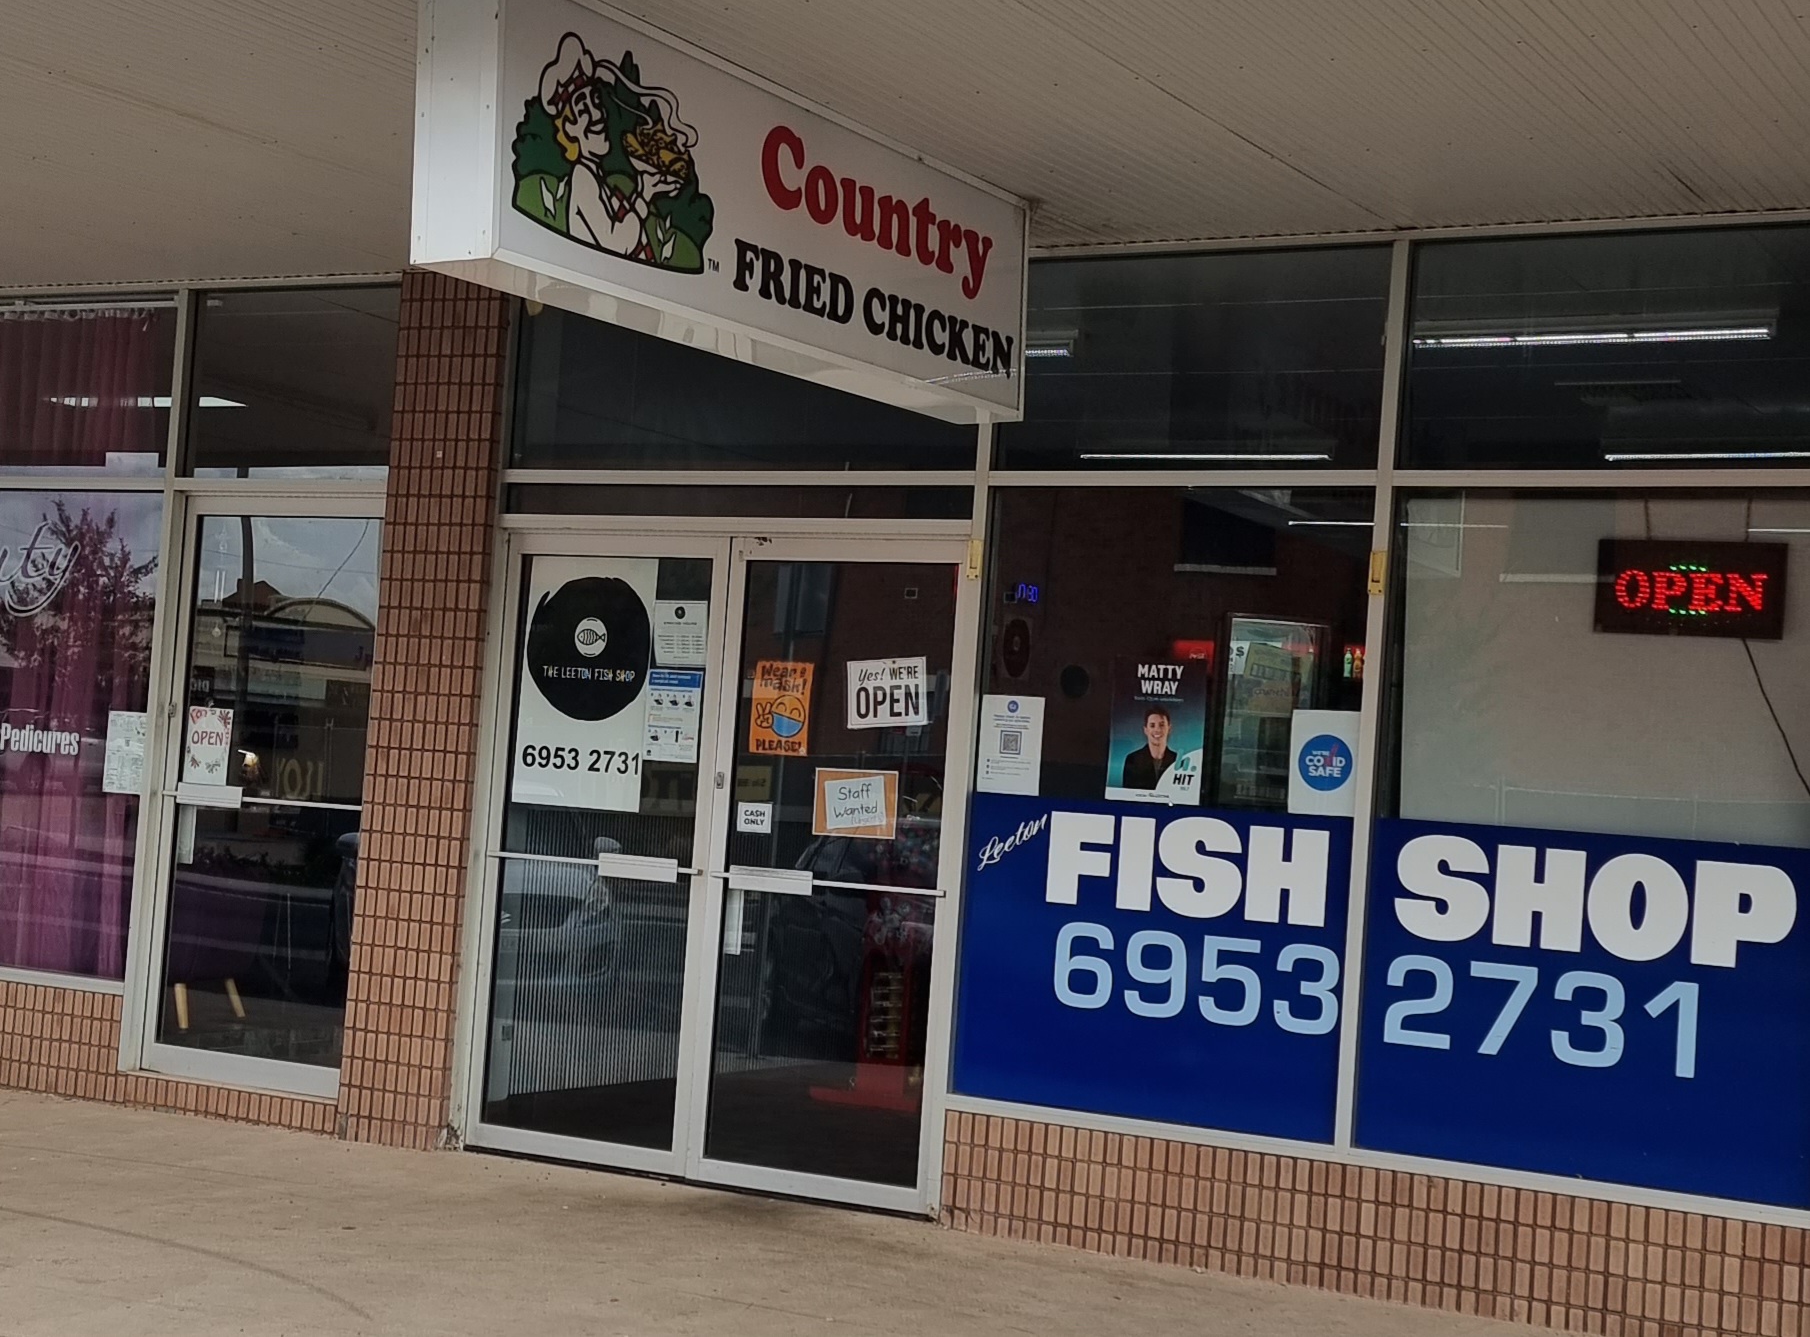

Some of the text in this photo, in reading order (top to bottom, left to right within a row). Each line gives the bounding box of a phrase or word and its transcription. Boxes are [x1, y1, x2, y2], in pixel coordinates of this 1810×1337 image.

[761, 125, 993, 299] Country
[733, 238, 1014, 379] FRIED CHICKEN
[1615, 568, 1769, 612] OPEN
[542, 665, 559, 678] THE
[561, 666, 592, 680] LEETON
[594, 668, 613, 682] FISH
[615, 669, 636, 682] SHOP
[761, 663, 797, 679] Wear
[858, 665, 919, 686] Yes! WE'RE
[1137, 663, 1184, 680] MATTY
[759, 676, 808, 695] mask!
[1141, 679, 1178, 695] WRAY
[856, 683, 919, 720] OPEN
[0, 722, 80, 756] Pedicures
[191, 730, 224, 746] OPEN
[755, 738, 802, 752] PLEASE!
[522, 744, 580, 771] 6953
[587, 749, 640, 776] 2731
[1173, 773, 1195, 786] HIT
[1308, 766, 1342, 778] SAFE
[837, 783, 873, 801] Staff
[743, 809, 766, 818] CASH
[833, 800, 878, 818] Wanted
[743, 817, 766, 826] ONLY
[977, 813, 1048, 872] Leeton
[1046, 810, 1797, 968] FISH SHOP
[1054, 922, 1700, 1079] 6953 2731
